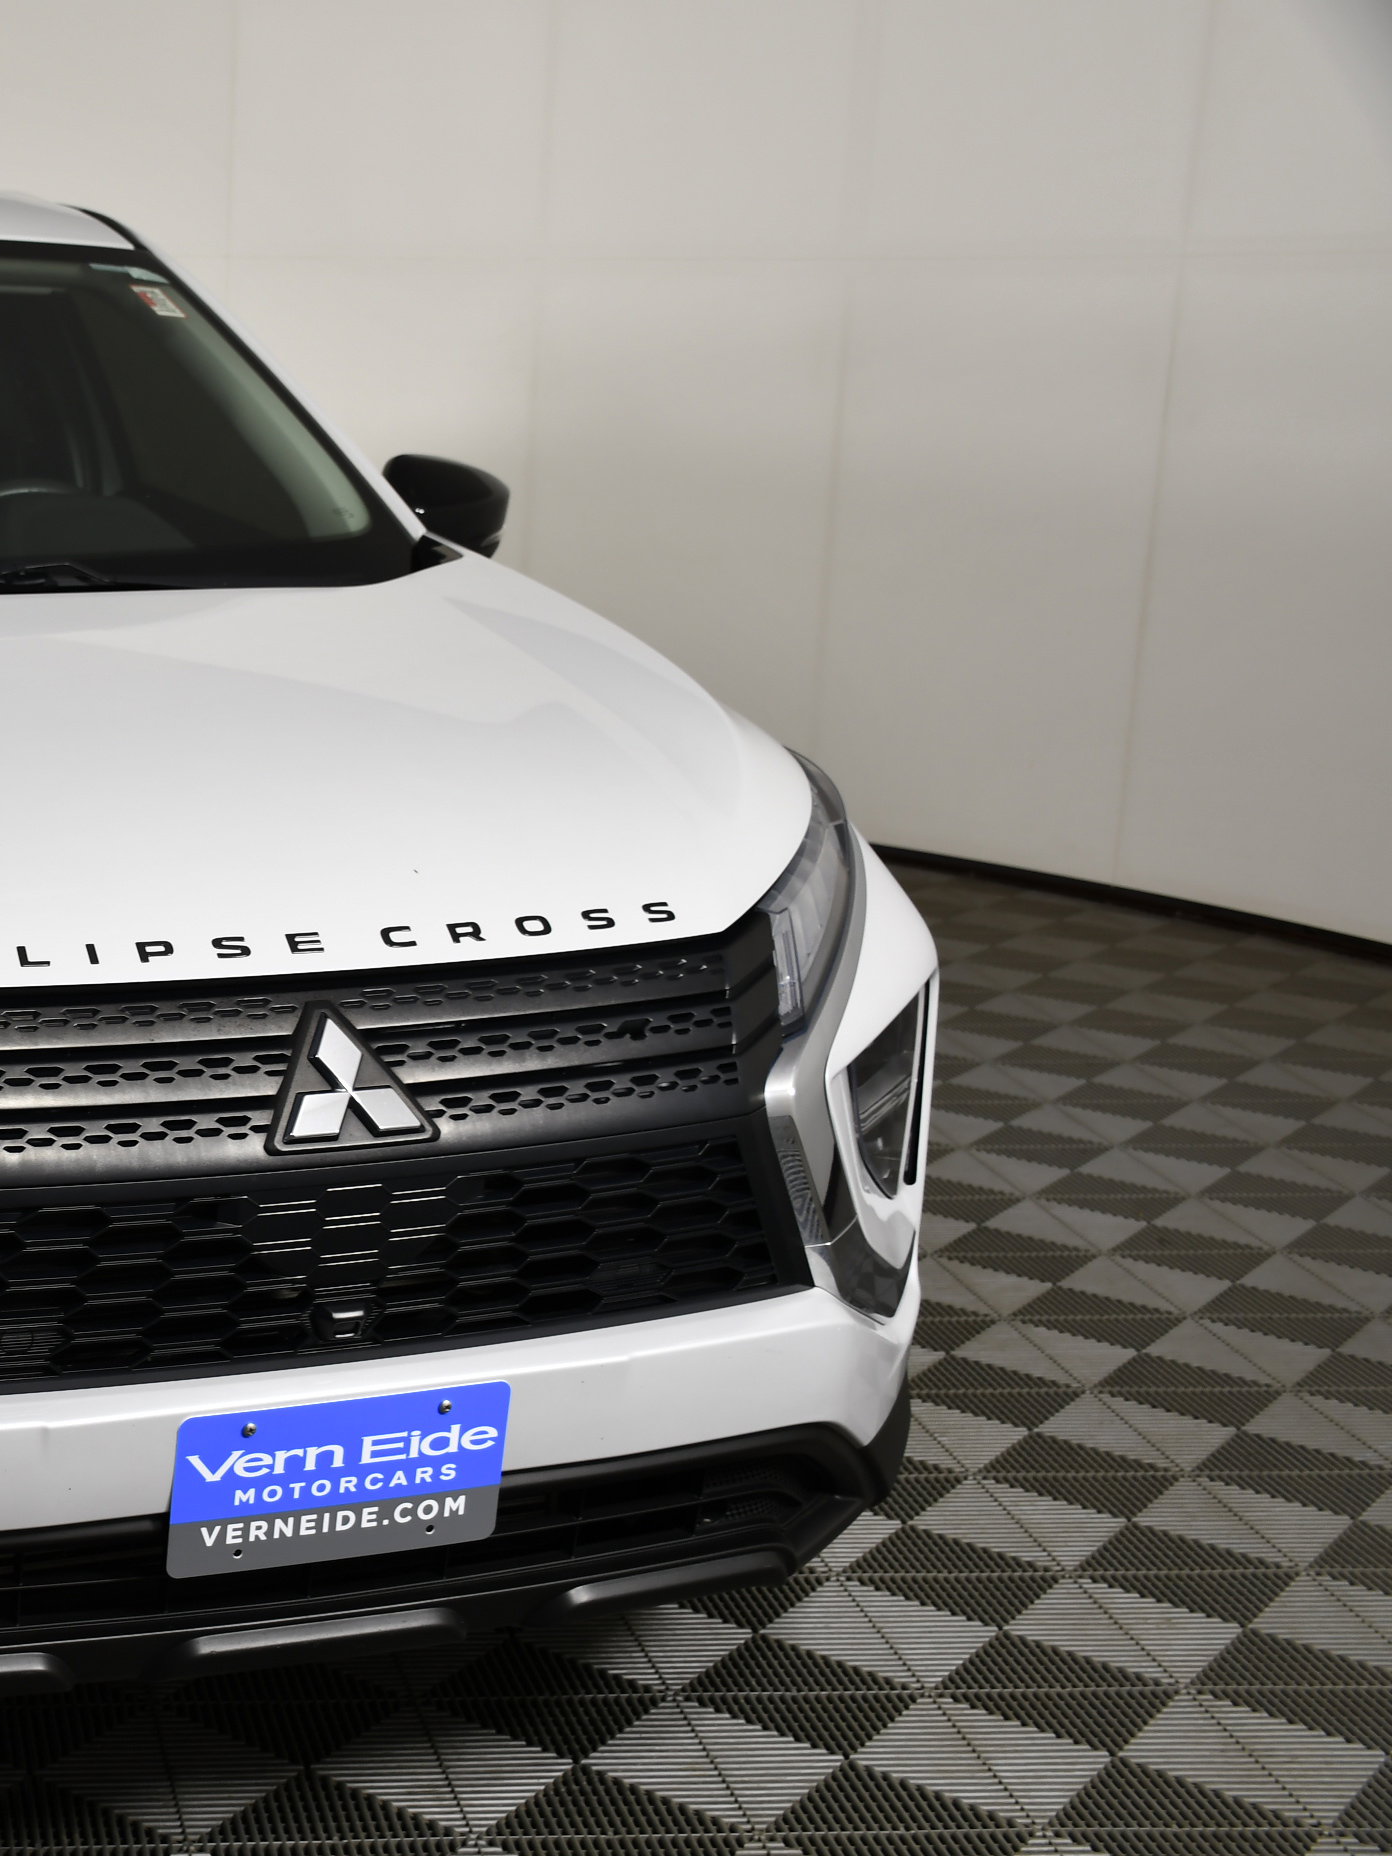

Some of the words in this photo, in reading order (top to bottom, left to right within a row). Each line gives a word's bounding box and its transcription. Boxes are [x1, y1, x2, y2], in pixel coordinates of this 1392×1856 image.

[379, 901, 677, 951] CROSS
[185, 1442, 346, 1482] Vern
[359, 1423, 499, 1465] Eide
[233, 1463, 458, 1506] MOTORCARS
[199, 1494, 467, 1548] VERNEIDE.COM
